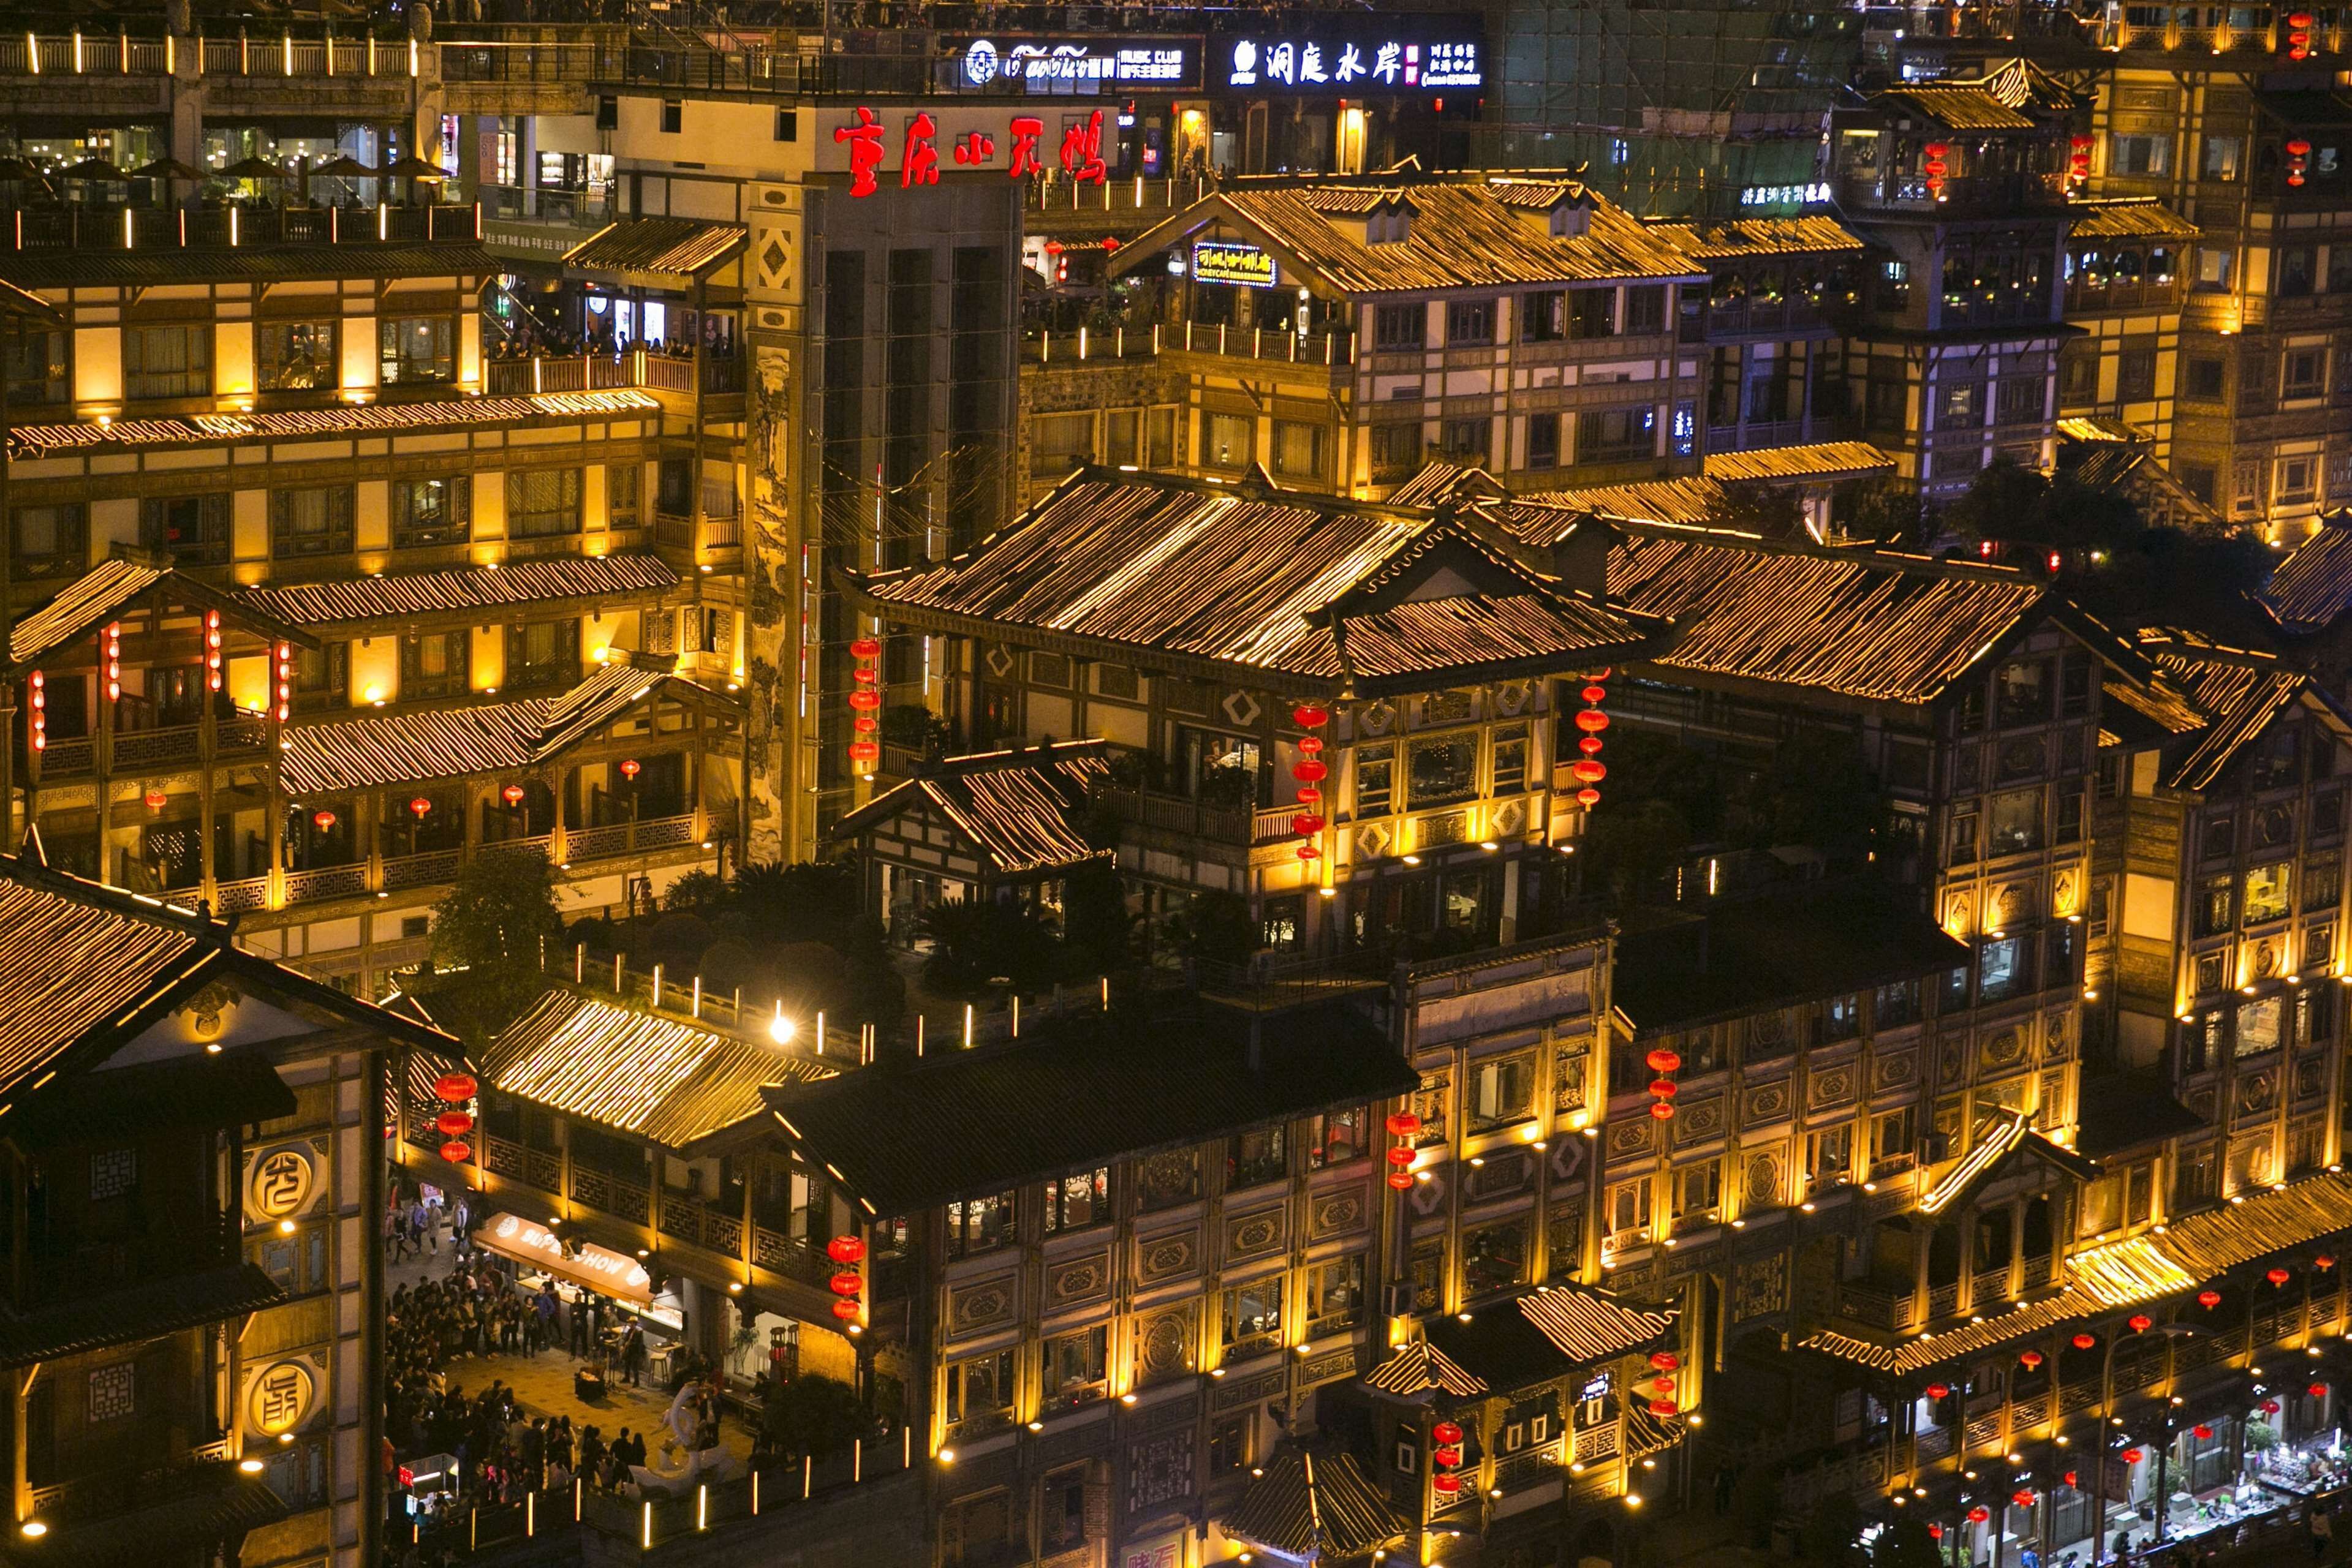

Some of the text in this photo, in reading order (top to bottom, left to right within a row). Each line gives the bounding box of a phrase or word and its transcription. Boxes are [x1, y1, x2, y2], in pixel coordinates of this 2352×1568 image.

[1121, 50, 1181, 63] MUSIC CLUB
[1266, 42, 1401, 85] 洞庭水岸
[834, 106, 1106, 197] 重庆小天鹅
